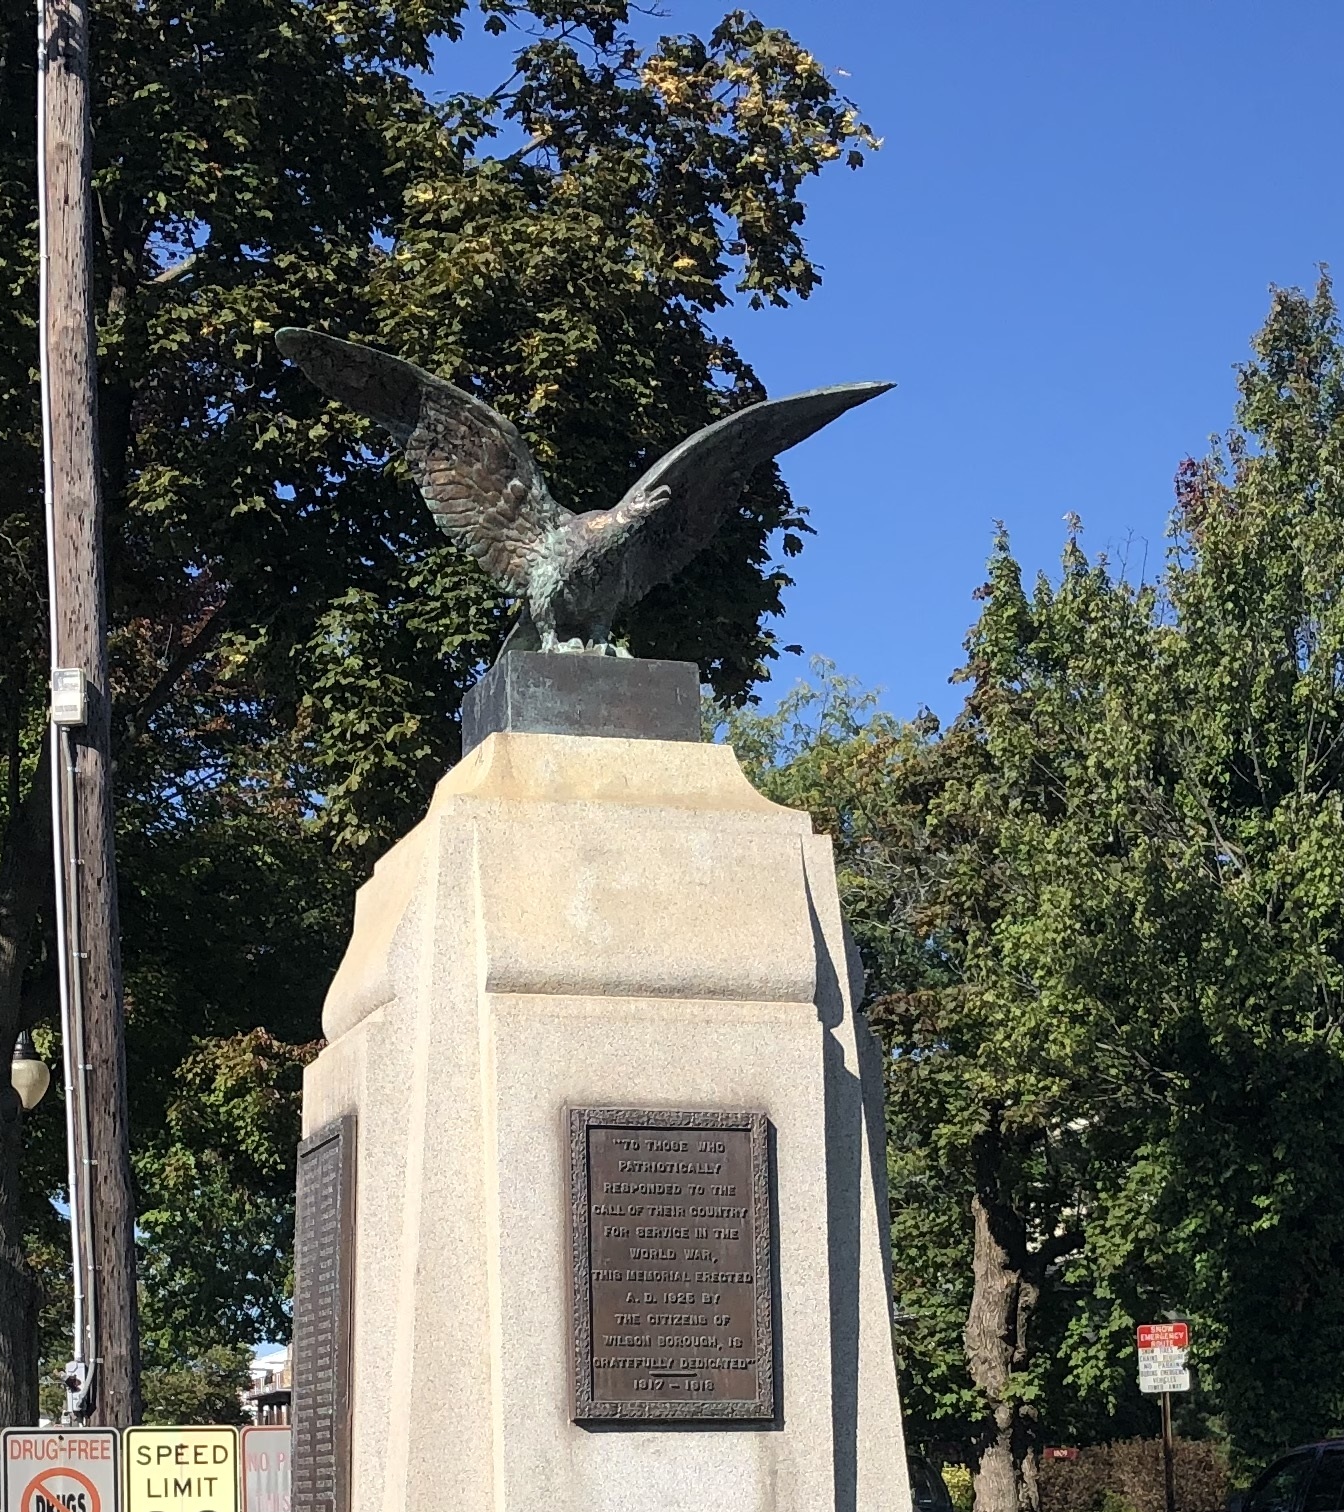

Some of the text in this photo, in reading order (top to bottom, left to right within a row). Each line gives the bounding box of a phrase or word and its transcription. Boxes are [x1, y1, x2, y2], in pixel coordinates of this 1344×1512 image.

[645, 1140, 689, 1152] THOSE
[697, 1141, 726, 1153] WHO
[618, 1160, 722, 1174] PATRIOTICALLY
[604, 1182, 736, 1196] RESPONDED TO THE
[592, 1204, 748, 1219] CALL OF THEIR COUNTRY
[604, 1225, 739, 1240] FOR SERVICE IN THE
[630, 1248, 718, 1264] WORLD WAR,
[592, 1269, 754, 1284] THIS MEMORIAL ERECTED
[626, 1292, 721, 1305] A. D. 1925 BY
[614, 1313, 731, 1326] THE CITIZENS OF
[602, 1335, 743, 1351] WILSON BOROUGH, IS
[593, 1356, 674, 1369] GRATEFULLY
[633, 1379, 665, 1391] 1917
[684, 1379, 715, 1391] 1918
[10, 1438, 111, 1461] DRUG-FREE
[136, 1444, 229, 1466] SPEED
[247, 1451, 269, 1473] NO
[147, 1477, 218, 1498] LIMIT
